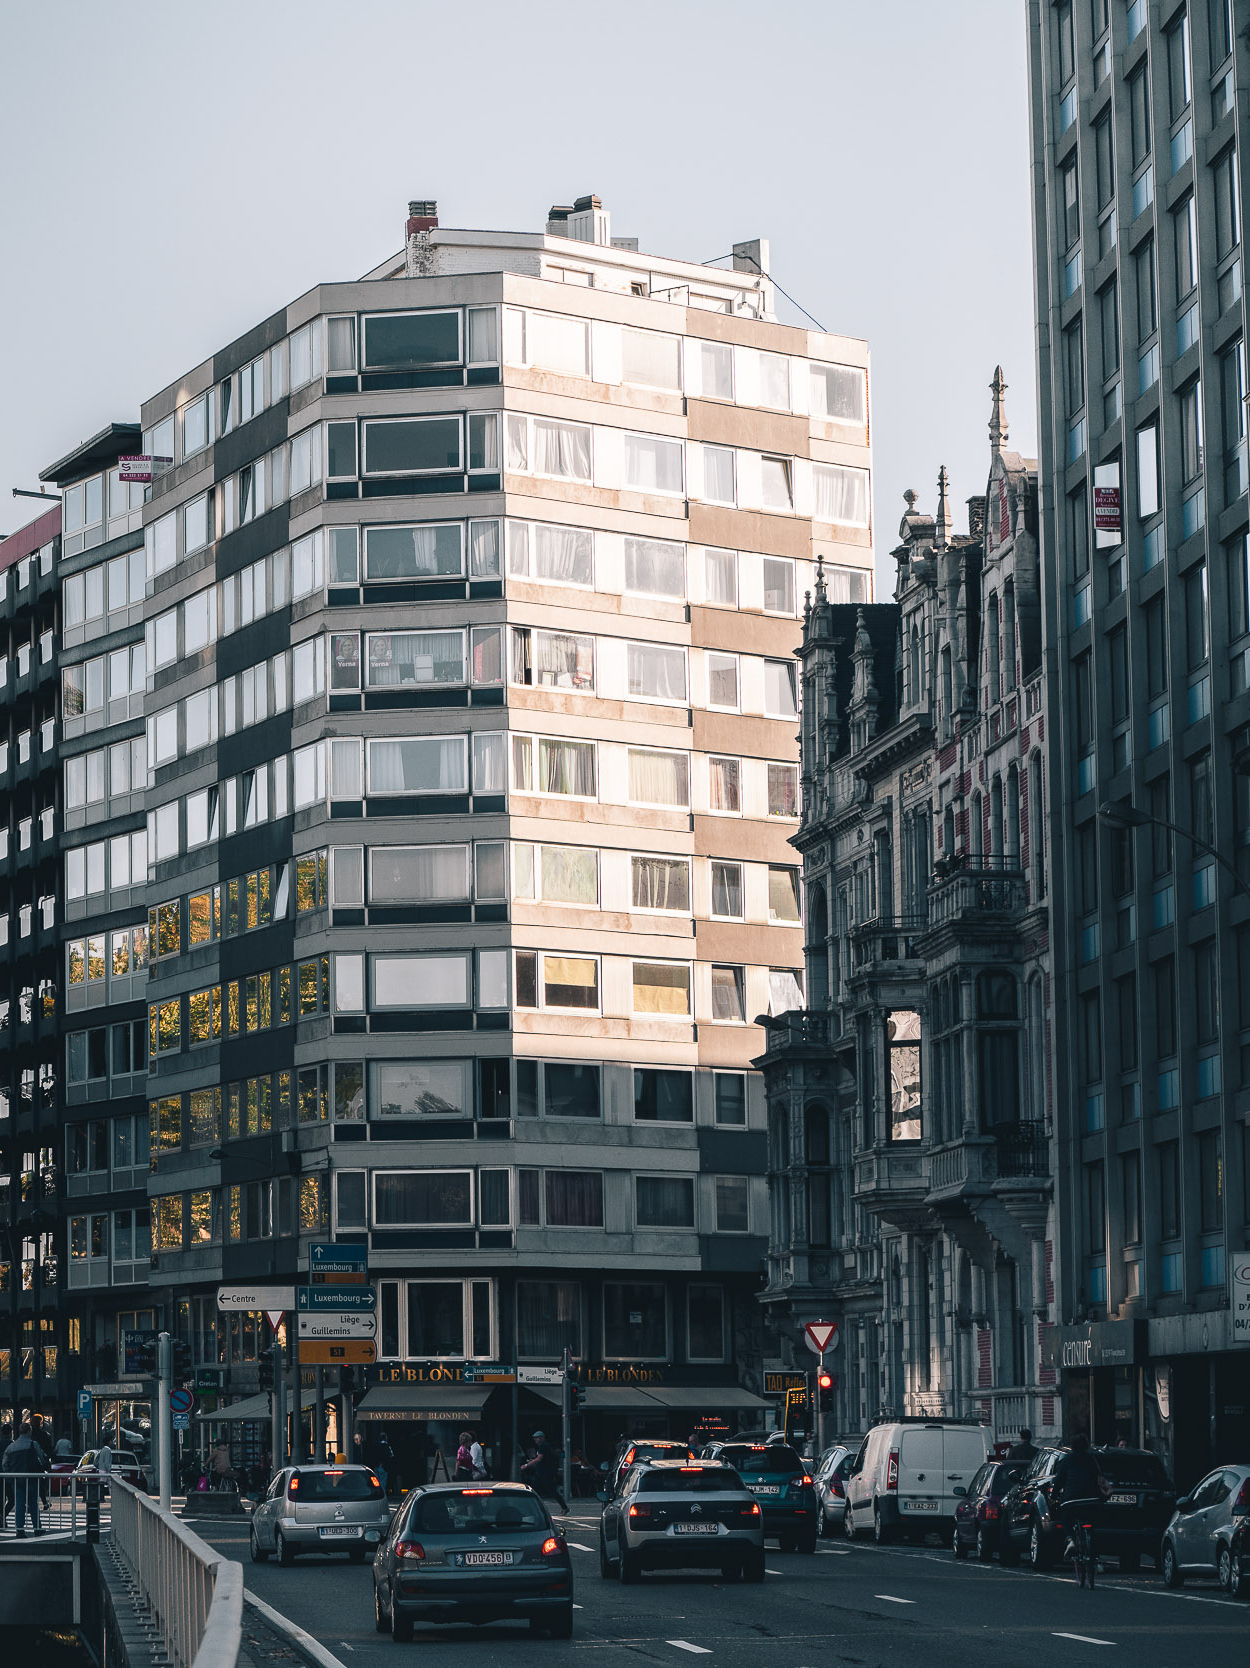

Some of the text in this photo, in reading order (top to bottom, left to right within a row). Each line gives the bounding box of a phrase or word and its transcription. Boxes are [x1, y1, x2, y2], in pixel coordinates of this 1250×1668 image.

[312, 1263, 352, 1272] Luxembourg
[231, 1295, 256, 1303] Centre
[314, 1293, 360, 1304] Luxembourg
[340, 1315, 360, 1324] Liège
[311, 1327, 351, 1335] Guillemins
[1062, 1326, 1092, 1366] censuré
[379, 1368, 400, 1382] LE
[473, 1367, 505, 1375] Luxembourg
[587, 1369, 663, 1383] LE BLONDEN
[79, 1393, 90, 1409] P
[369, 1412, 470, 1420] TAVERNE LE BLONDEN
